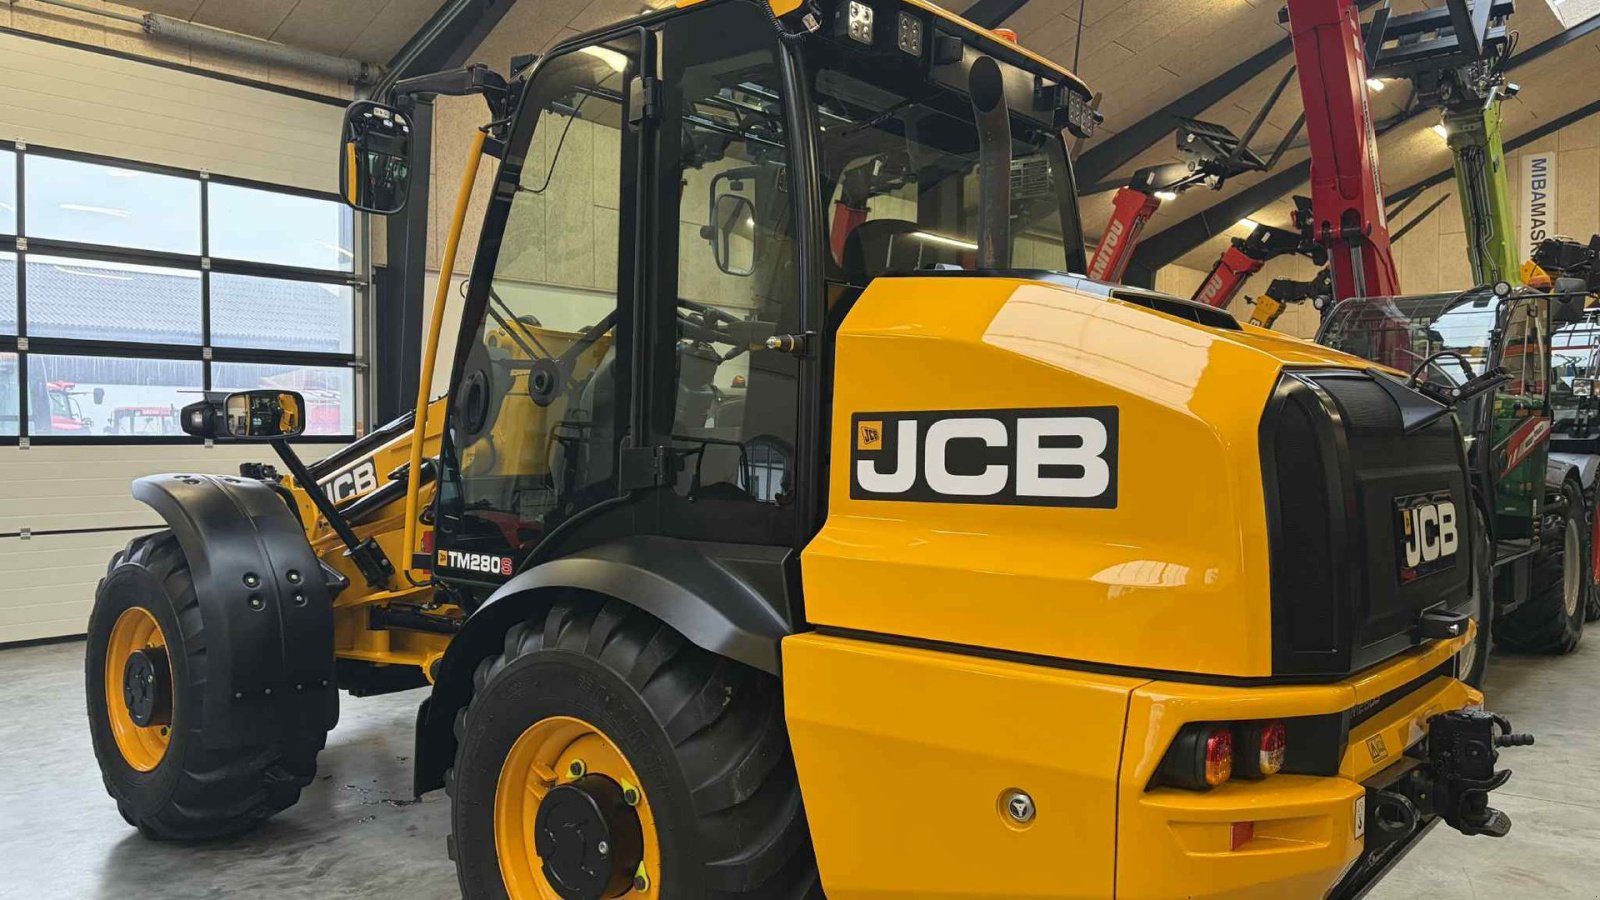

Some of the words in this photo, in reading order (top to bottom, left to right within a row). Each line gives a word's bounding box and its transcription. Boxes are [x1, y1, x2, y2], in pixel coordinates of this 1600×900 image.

[1530, 158, 1547, 257] MIBAMASK
[1089, 219, 1124, 280] ANITOU
[857, 416, 1110, 498] JCB
[448, 551, 513, 575] TM280S
[1405, 502, 1459, 568] JCB
